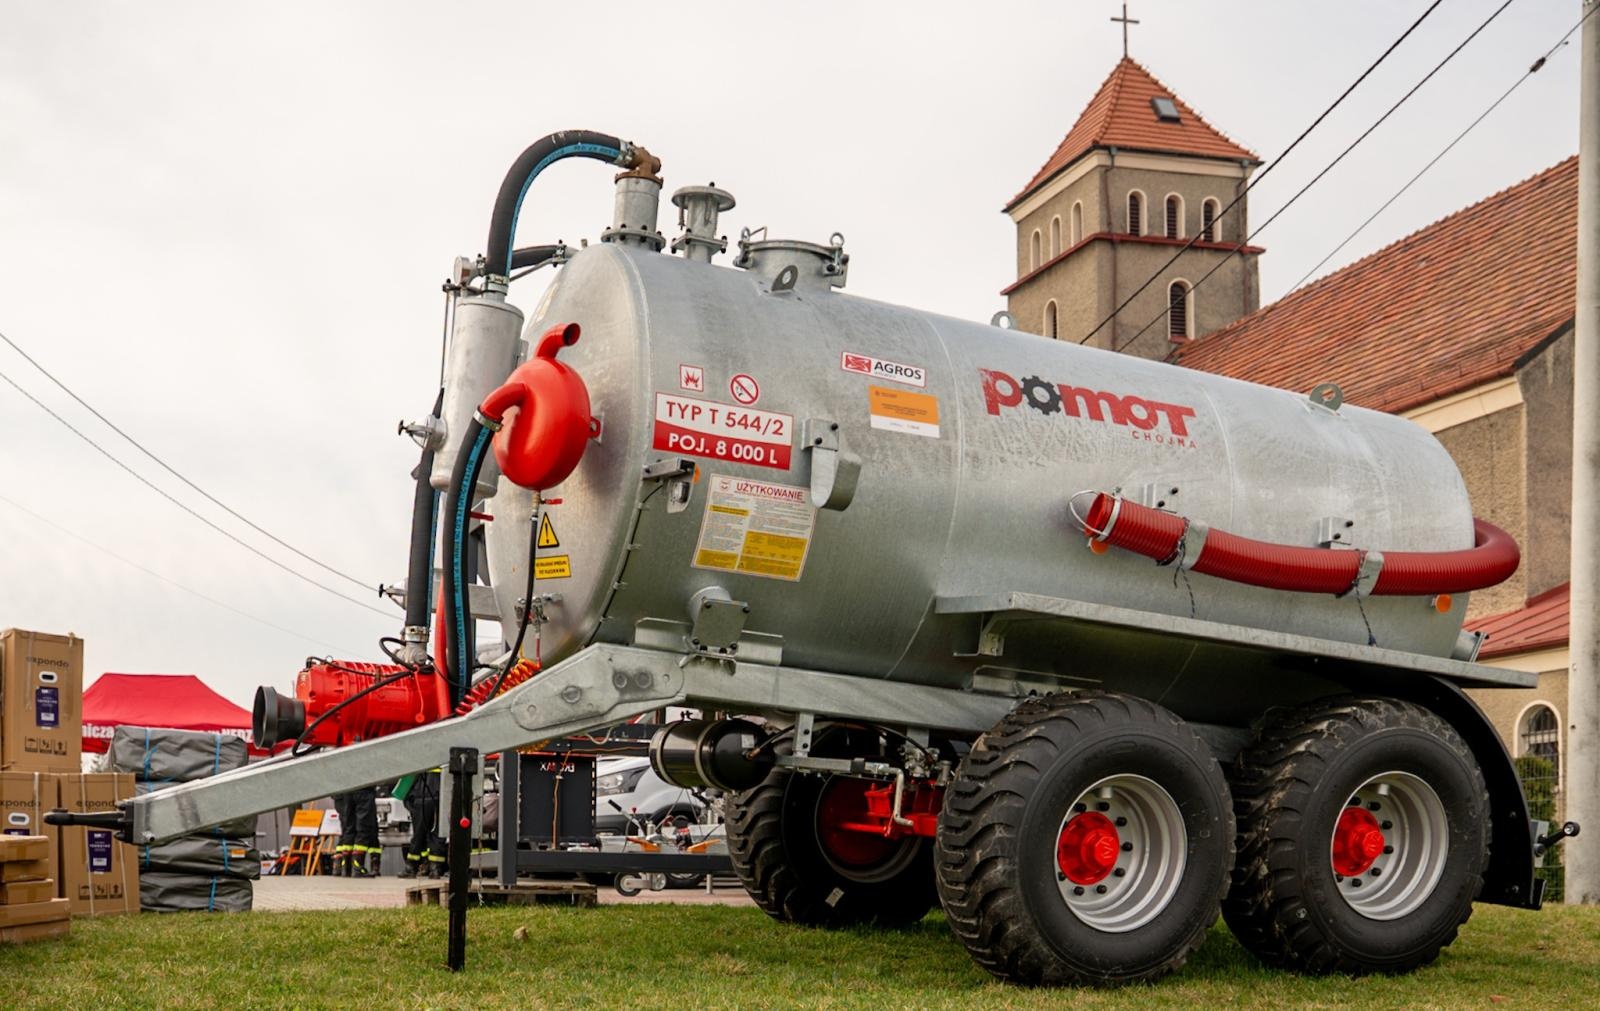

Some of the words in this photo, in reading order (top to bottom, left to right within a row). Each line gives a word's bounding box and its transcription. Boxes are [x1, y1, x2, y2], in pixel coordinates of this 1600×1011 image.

[874, 361, 922, 380] AGROS
[666, 401, 702, 421] TYP
[709, 408, 719, 425] T
[725, 412, 784, 437] 544/2
[668, 432, 710, 454] POJ.
[715, 440, 727, 456] 8
[732, 443, 764, 462] 000
[769, 449, 778, 465] L
[1132, 430, 1198, 449] CHOJNA
[736, 481, 804, 501] UŻYTKOWANIE
